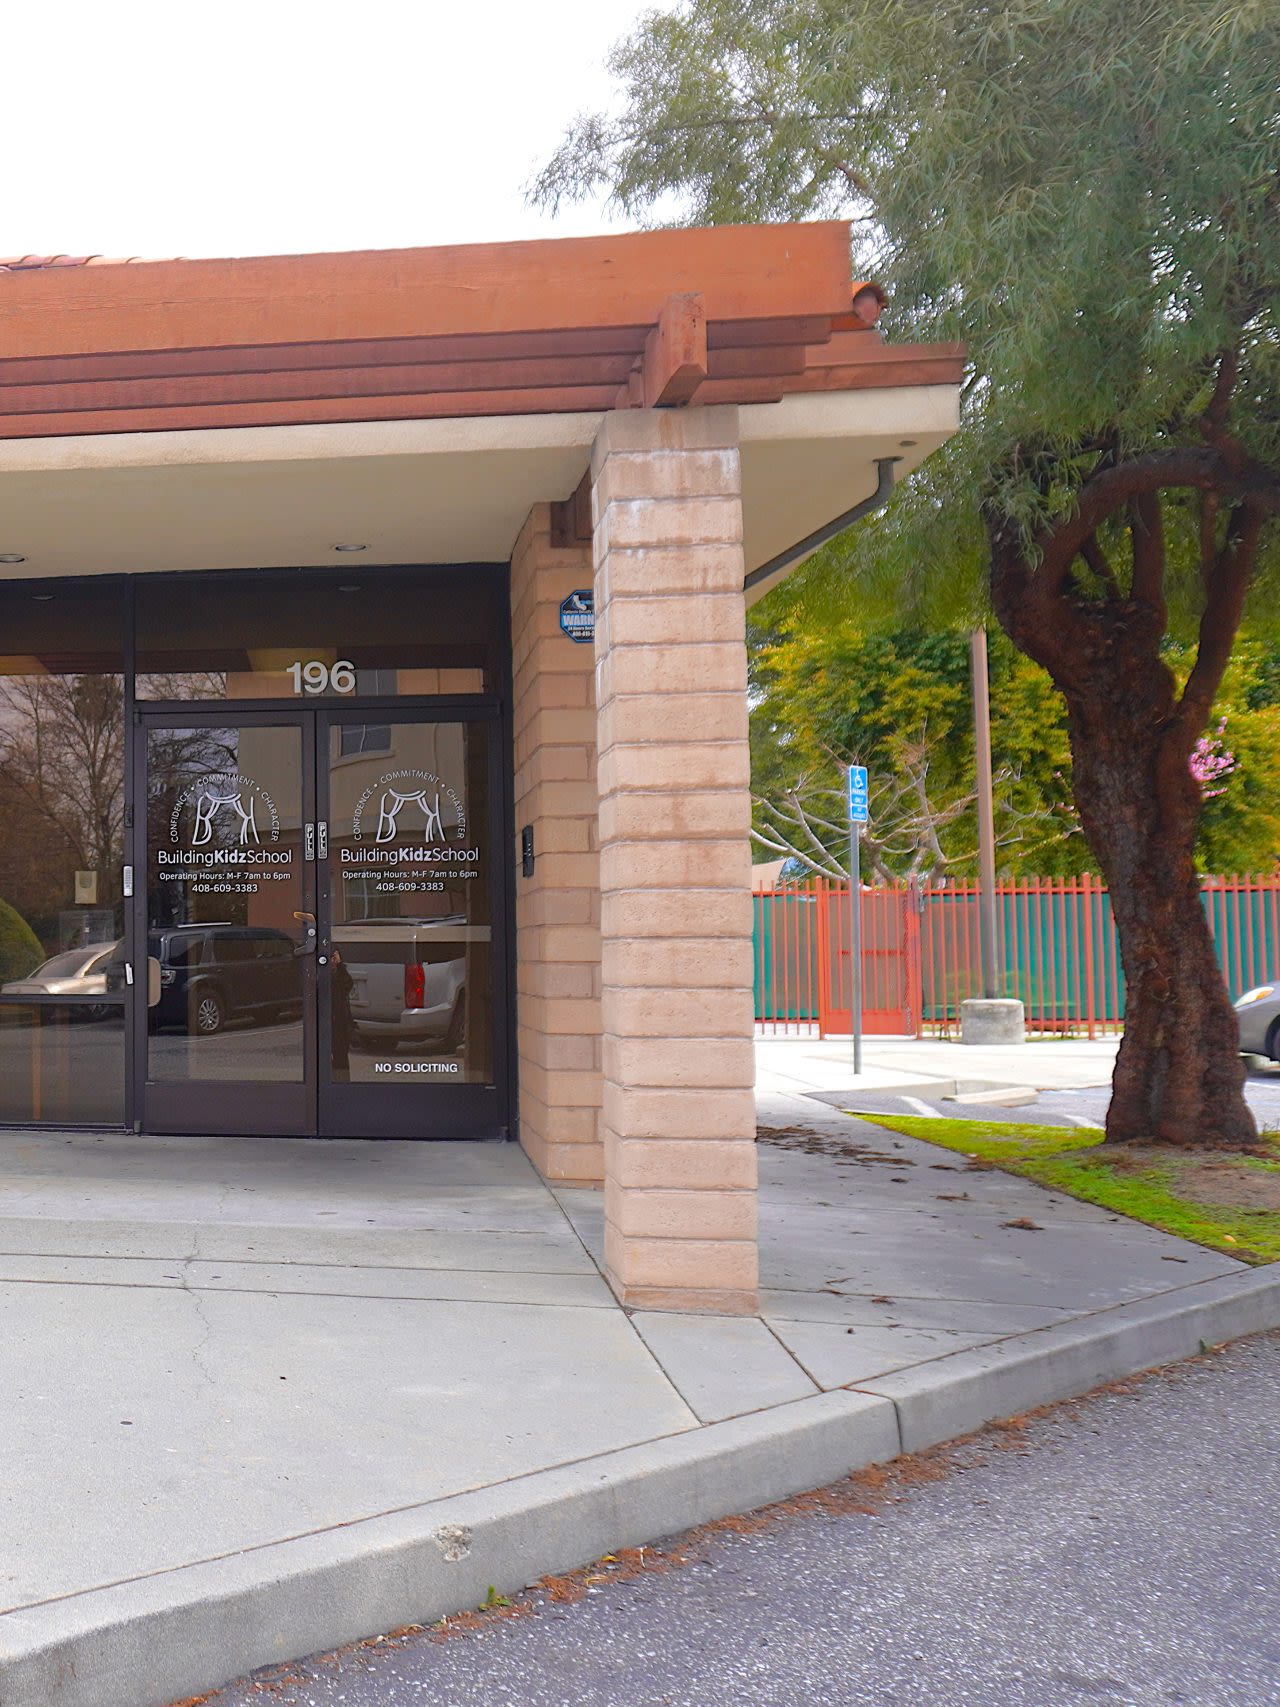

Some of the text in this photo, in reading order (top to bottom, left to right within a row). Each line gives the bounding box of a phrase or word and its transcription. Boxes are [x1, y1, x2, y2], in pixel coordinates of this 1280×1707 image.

[563, 615, 595, 625] WARN
[286, 660, 355, 694] 196
[197, 772, 255, 787] COMMITMENT
[380, 769, 440, 784] COMMITMENT
[171, 791, 191, 843] CONFIDENCE
[261, 791, 280, 841] CHARACTER
[353, 787, 374, 841] CONFIDENCE
[446, 788, 467, 839] CHARACTER
[158, 849, 292, 867] BuildingKidzSchool
[341, 847, 479, 865] BuildingKidzSchool
[159, 872, 291, 882] Operating Hours: M-F 7am to 6pm
[342, 870, 478, 880] Operating Hours: M-F 7am to 6pm
[191, 884, 258, 893] 408-609-3383
[376, 882, 444, 891] 408-609-3383
[375, 1063, 458, 1073] NO SOLICITING
